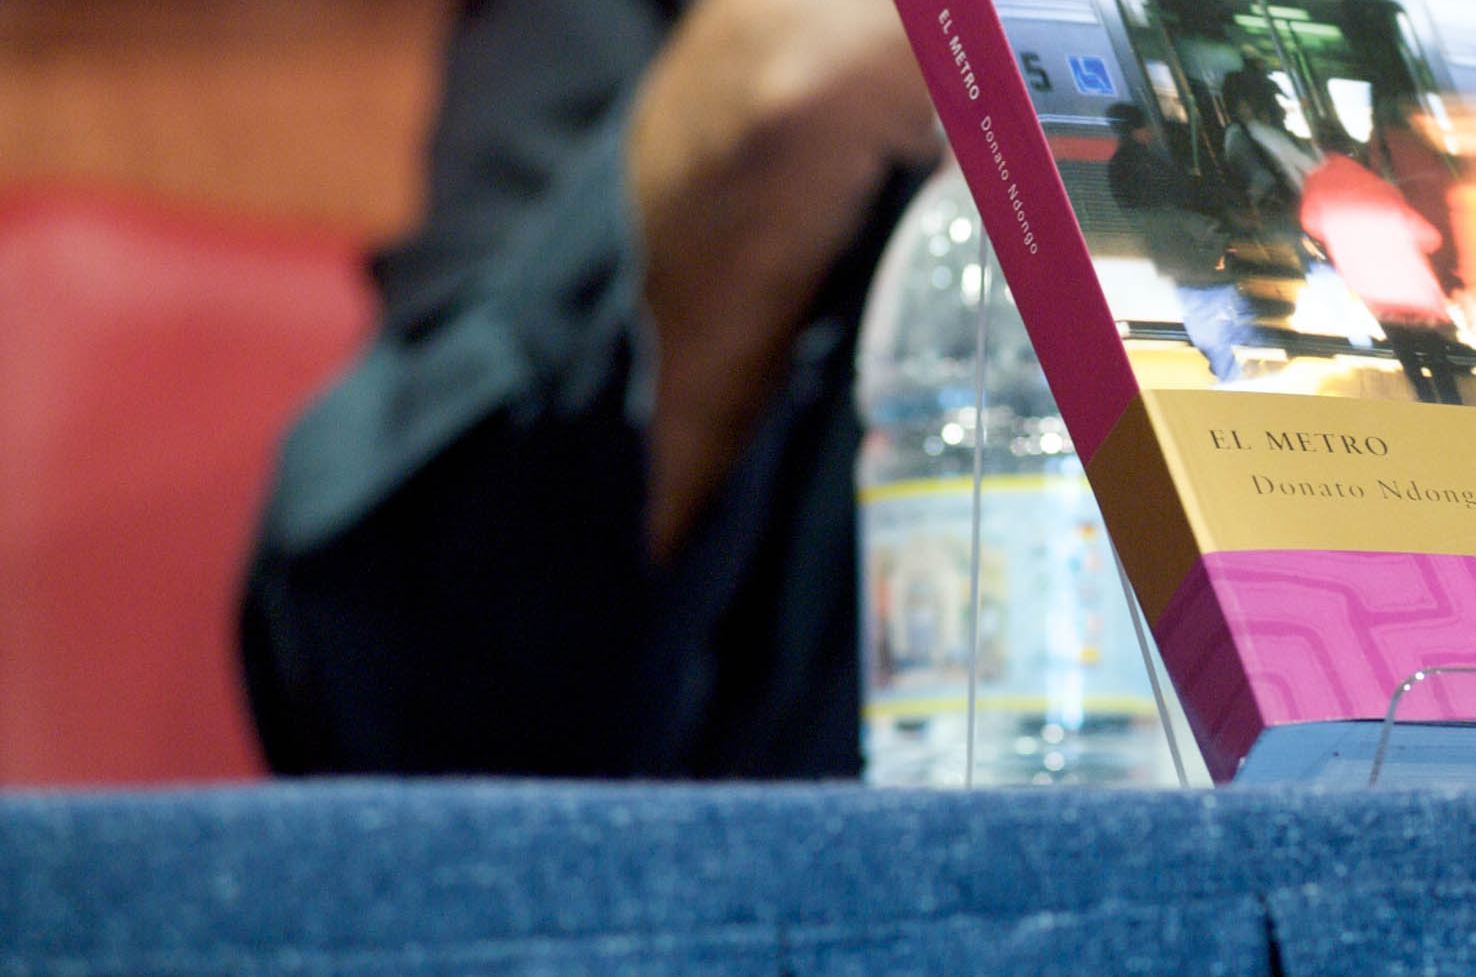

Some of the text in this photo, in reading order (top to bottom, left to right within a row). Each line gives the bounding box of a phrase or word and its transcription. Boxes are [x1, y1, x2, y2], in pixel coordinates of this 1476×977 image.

[1020, 51, 1053, 92] 5
[938, 8, 1038, 255] EL METRO Donato Ndongo
[1209, 429, 1390, 457] EL METRO
[1250, 473, 1365, 499] Donato
